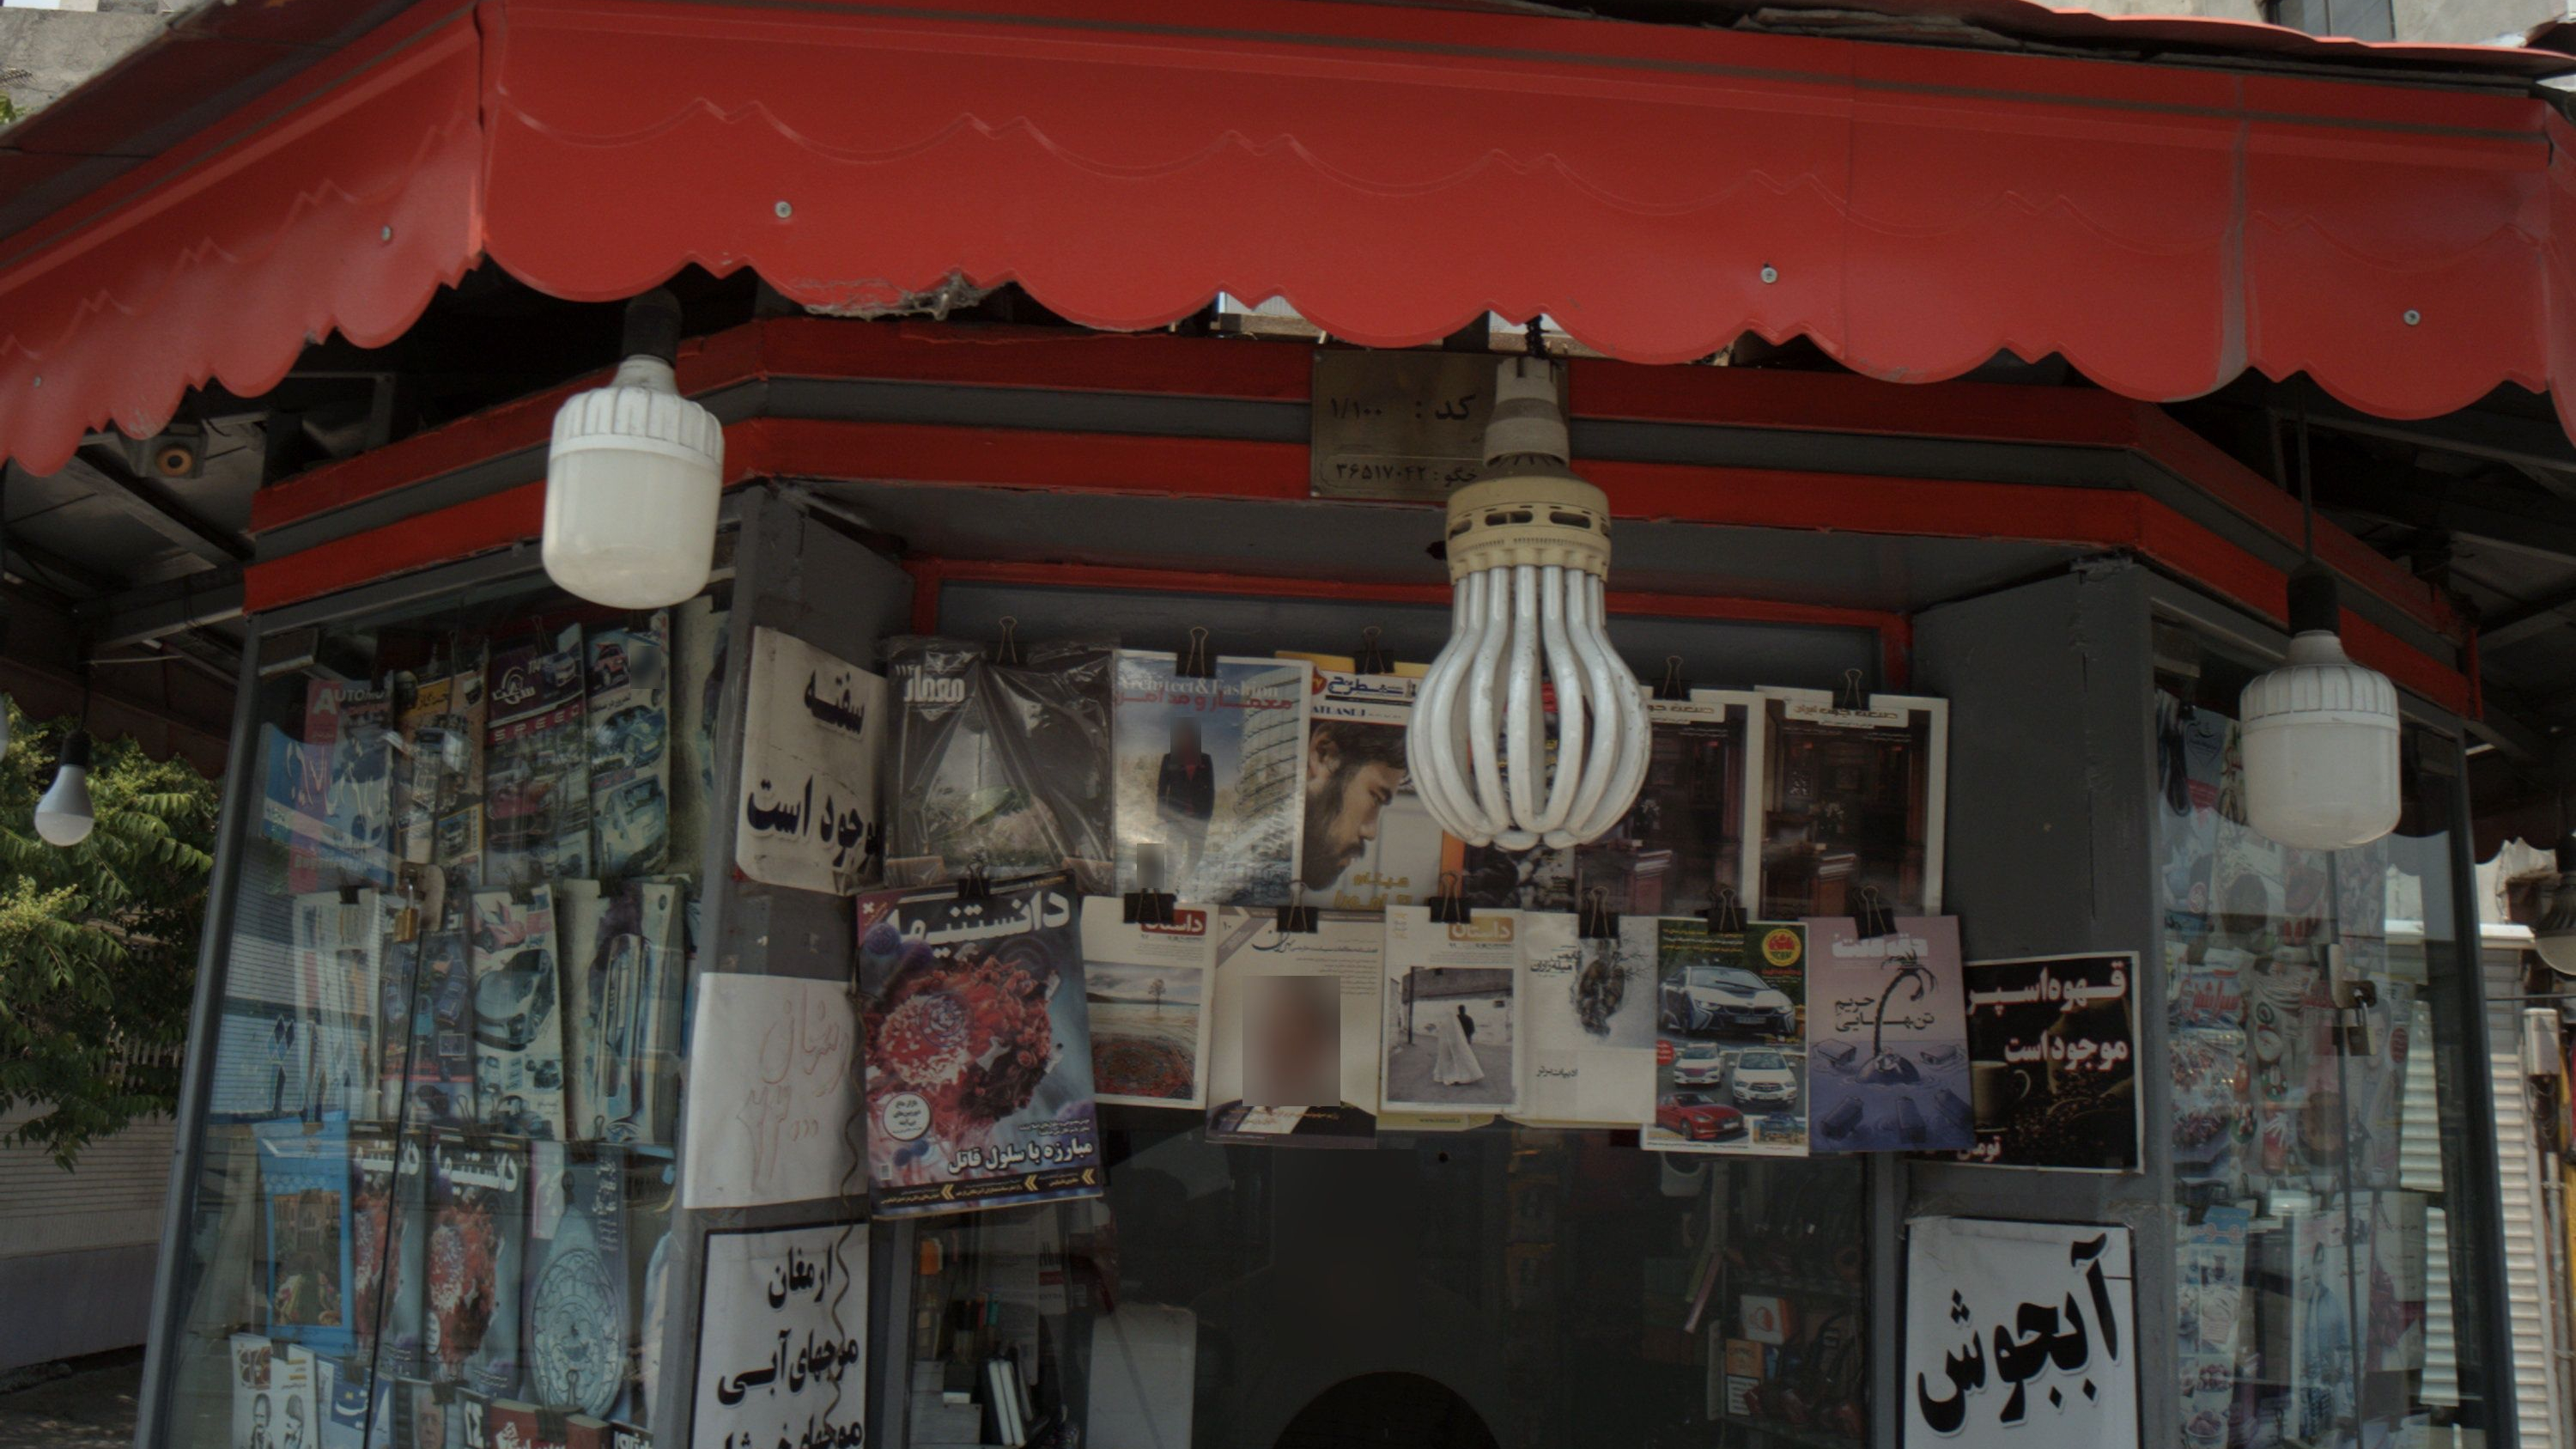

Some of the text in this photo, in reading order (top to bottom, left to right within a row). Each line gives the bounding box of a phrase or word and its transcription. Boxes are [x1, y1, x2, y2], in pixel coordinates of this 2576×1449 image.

[804, 671, 866, 735] سفته
[903, 665, 965, 703] معمار
[747, 775, 884, 874] موجود است
[2050, 960, 2128, 1013] قهوه
[2005, 1029, 2129, 1071] موجود است
[948, 1136, 1093, 1175] مبارزه با سلول قاتل
[769, 1243, 833, 1310] ارمغان
[1918, 1233, 2118, 1433] آبجوش
[717, 1327, 793, 1406] آبی
